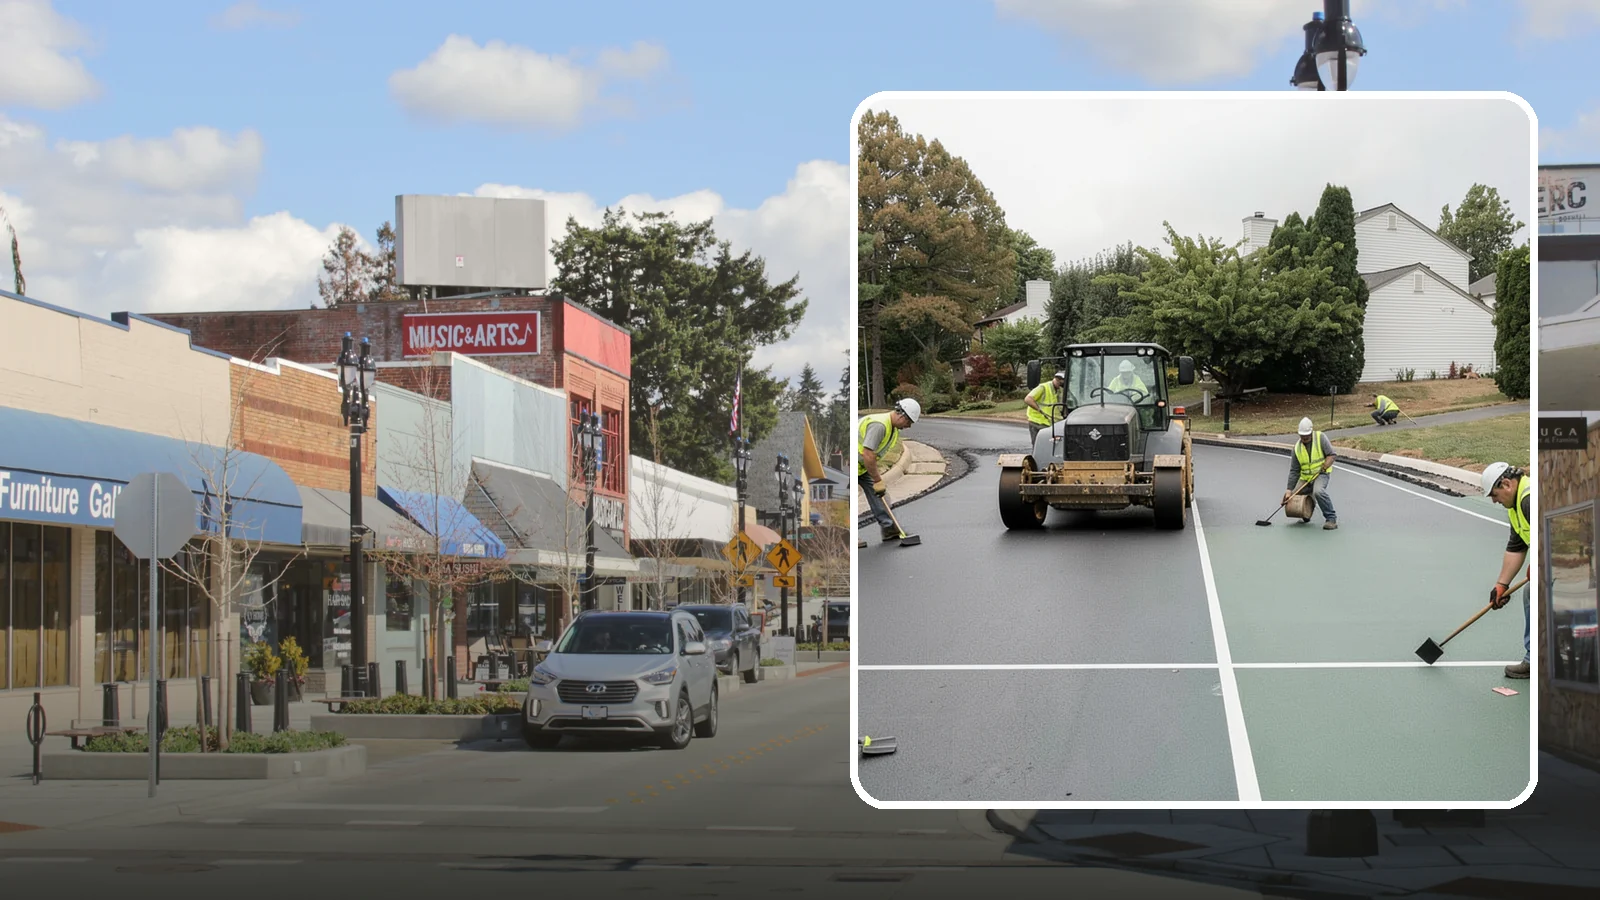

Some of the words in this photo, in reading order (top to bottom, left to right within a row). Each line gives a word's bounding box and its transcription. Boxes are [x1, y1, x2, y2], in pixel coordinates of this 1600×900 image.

[0, 471, 80, 515] Furniture
[89, 482, 122, 520] Gal
[453, 563, 479, 575] SUSHI
